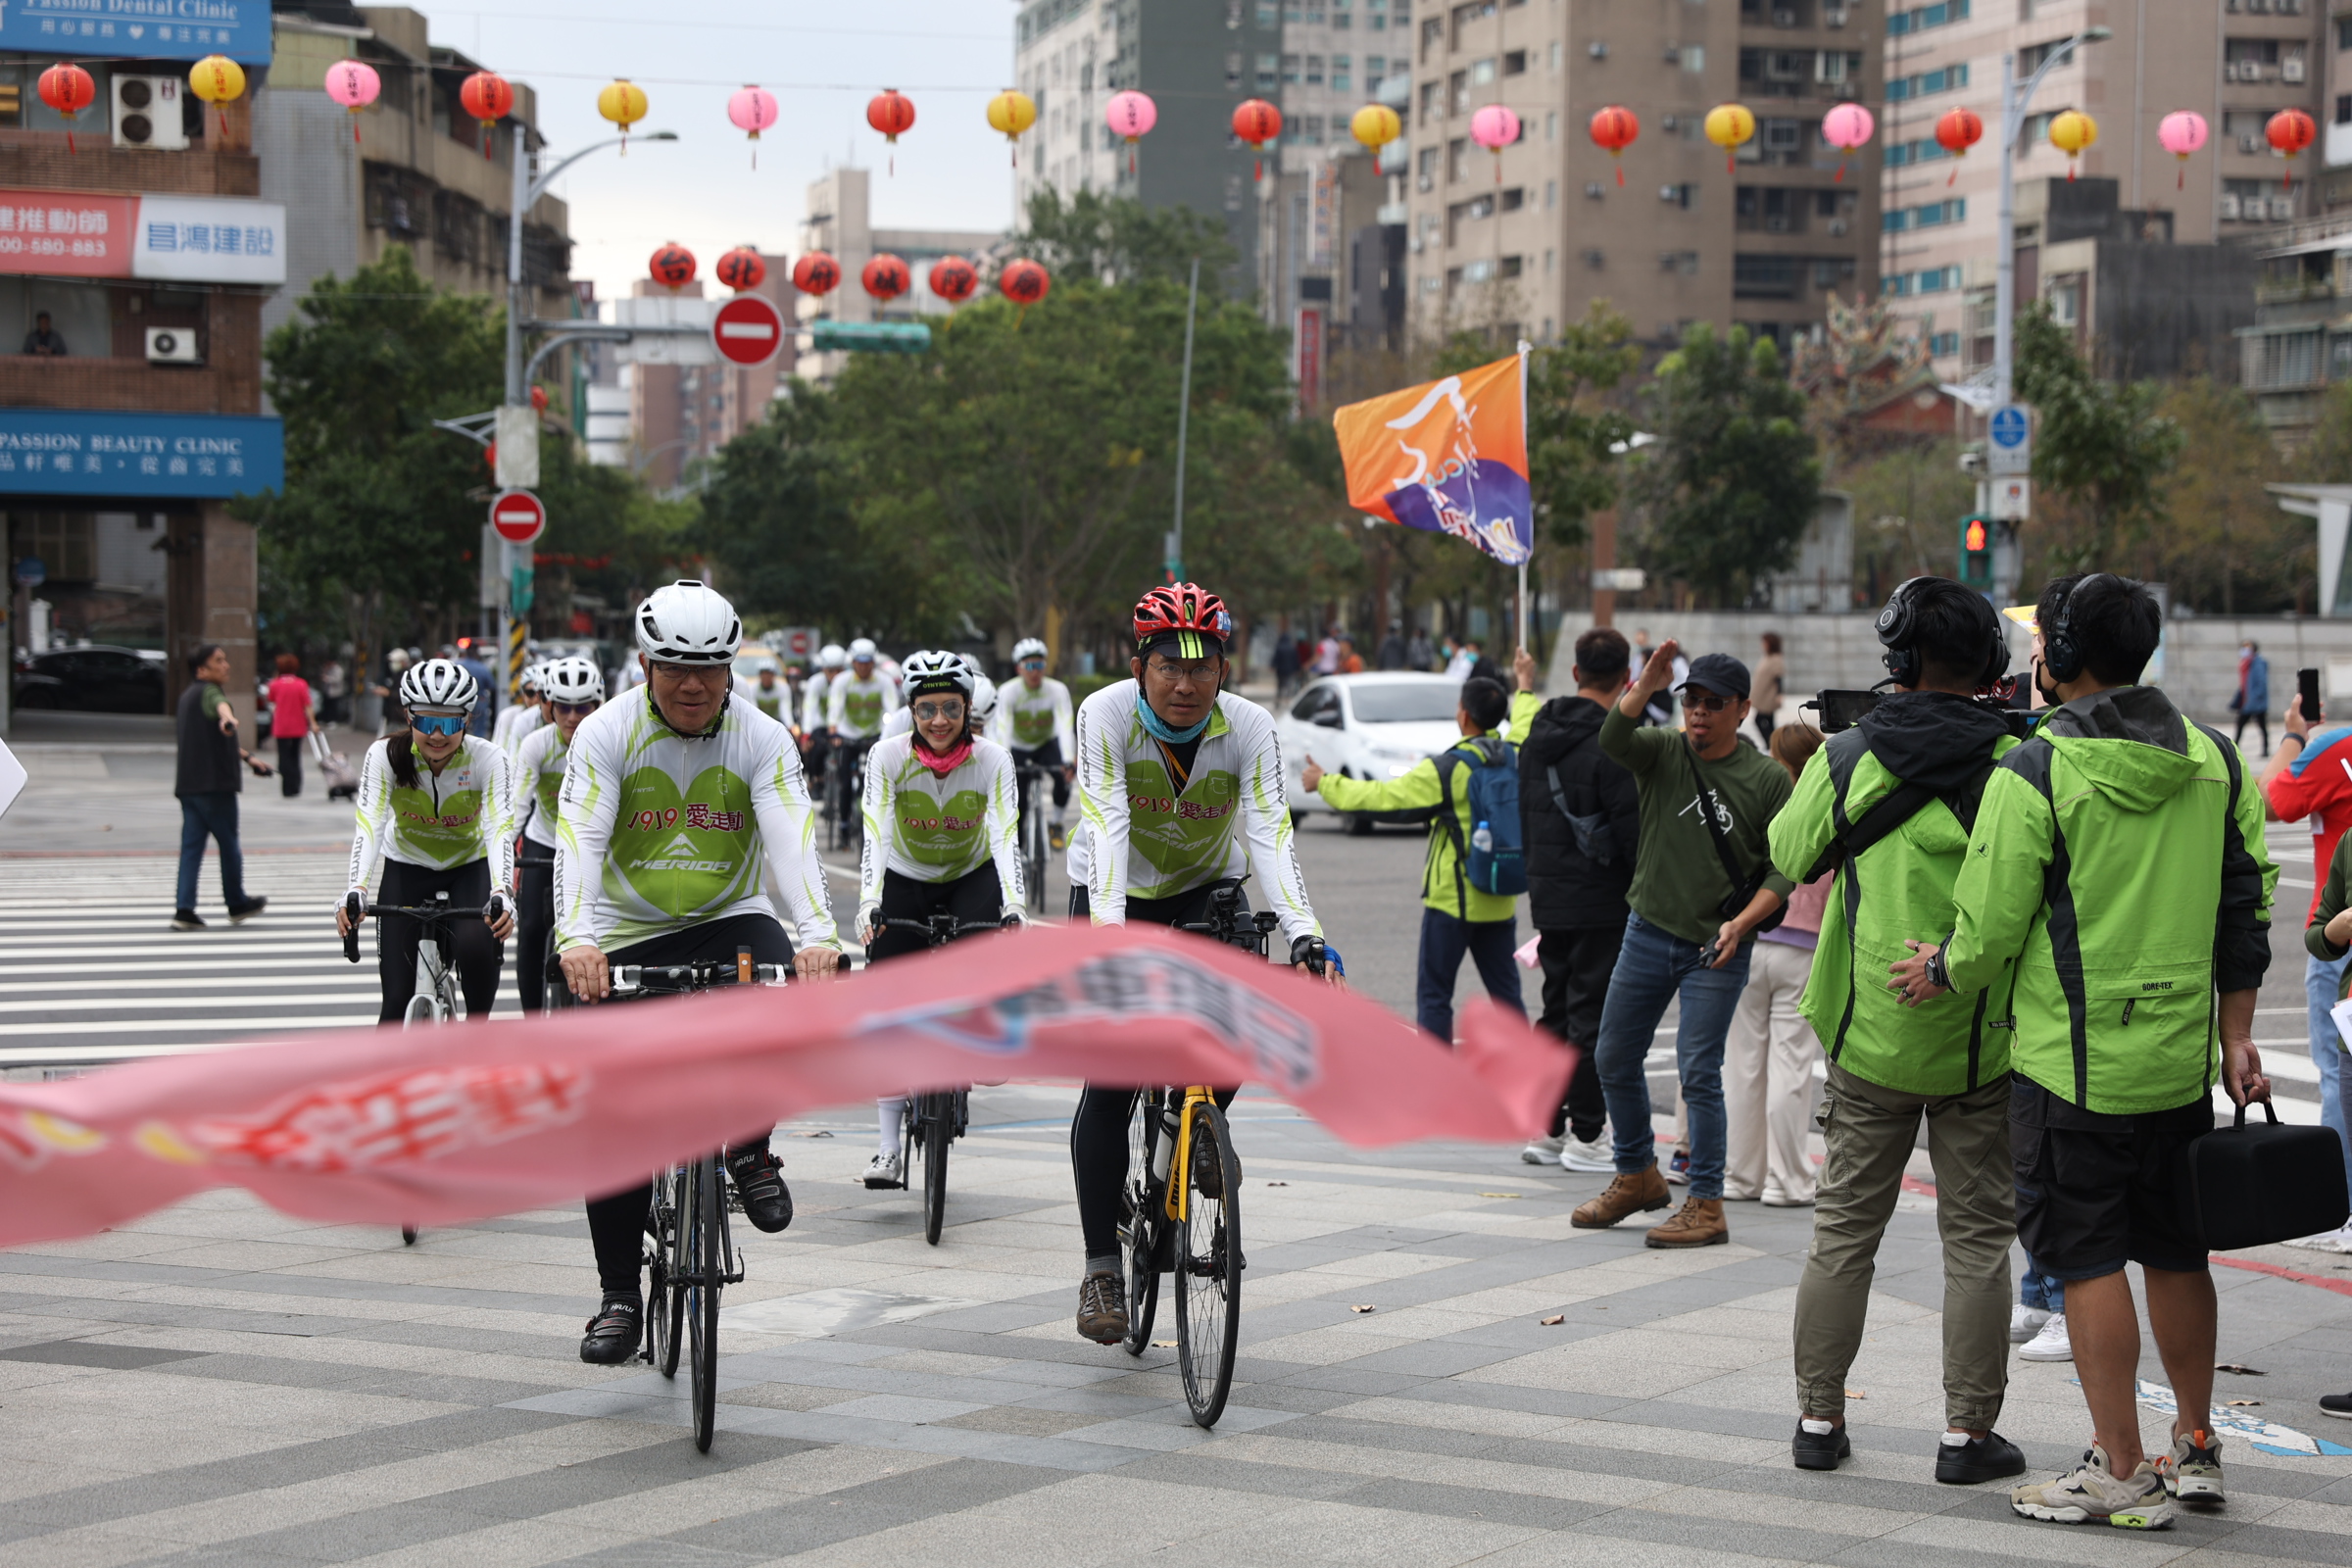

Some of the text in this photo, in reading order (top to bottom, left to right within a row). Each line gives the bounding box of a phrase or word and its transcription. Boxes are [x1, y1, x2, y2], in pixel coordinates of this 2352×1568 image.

[108, 0, 172, 17] Dental
[178, 0, 238, 20] Clinic
[90, 434, 167, 454] BEAUTY
[174, 436, 243, 457] CLINIC
[1077, 709, 1092, 789] MERIDA
[627, 803, 744, 832] 1919 愛走動
[1130, 825, 1214, 852] MERIDA
[502, 838, 513, 886] OTNYTEX
[629, 858, 733, 871] MERIDA
[1010, 841, 1025, 896] OTNYTEX
[554, 849, 565, 919] OTNYTEX
[2141, 981, 2175, 992] GORE-TEX
